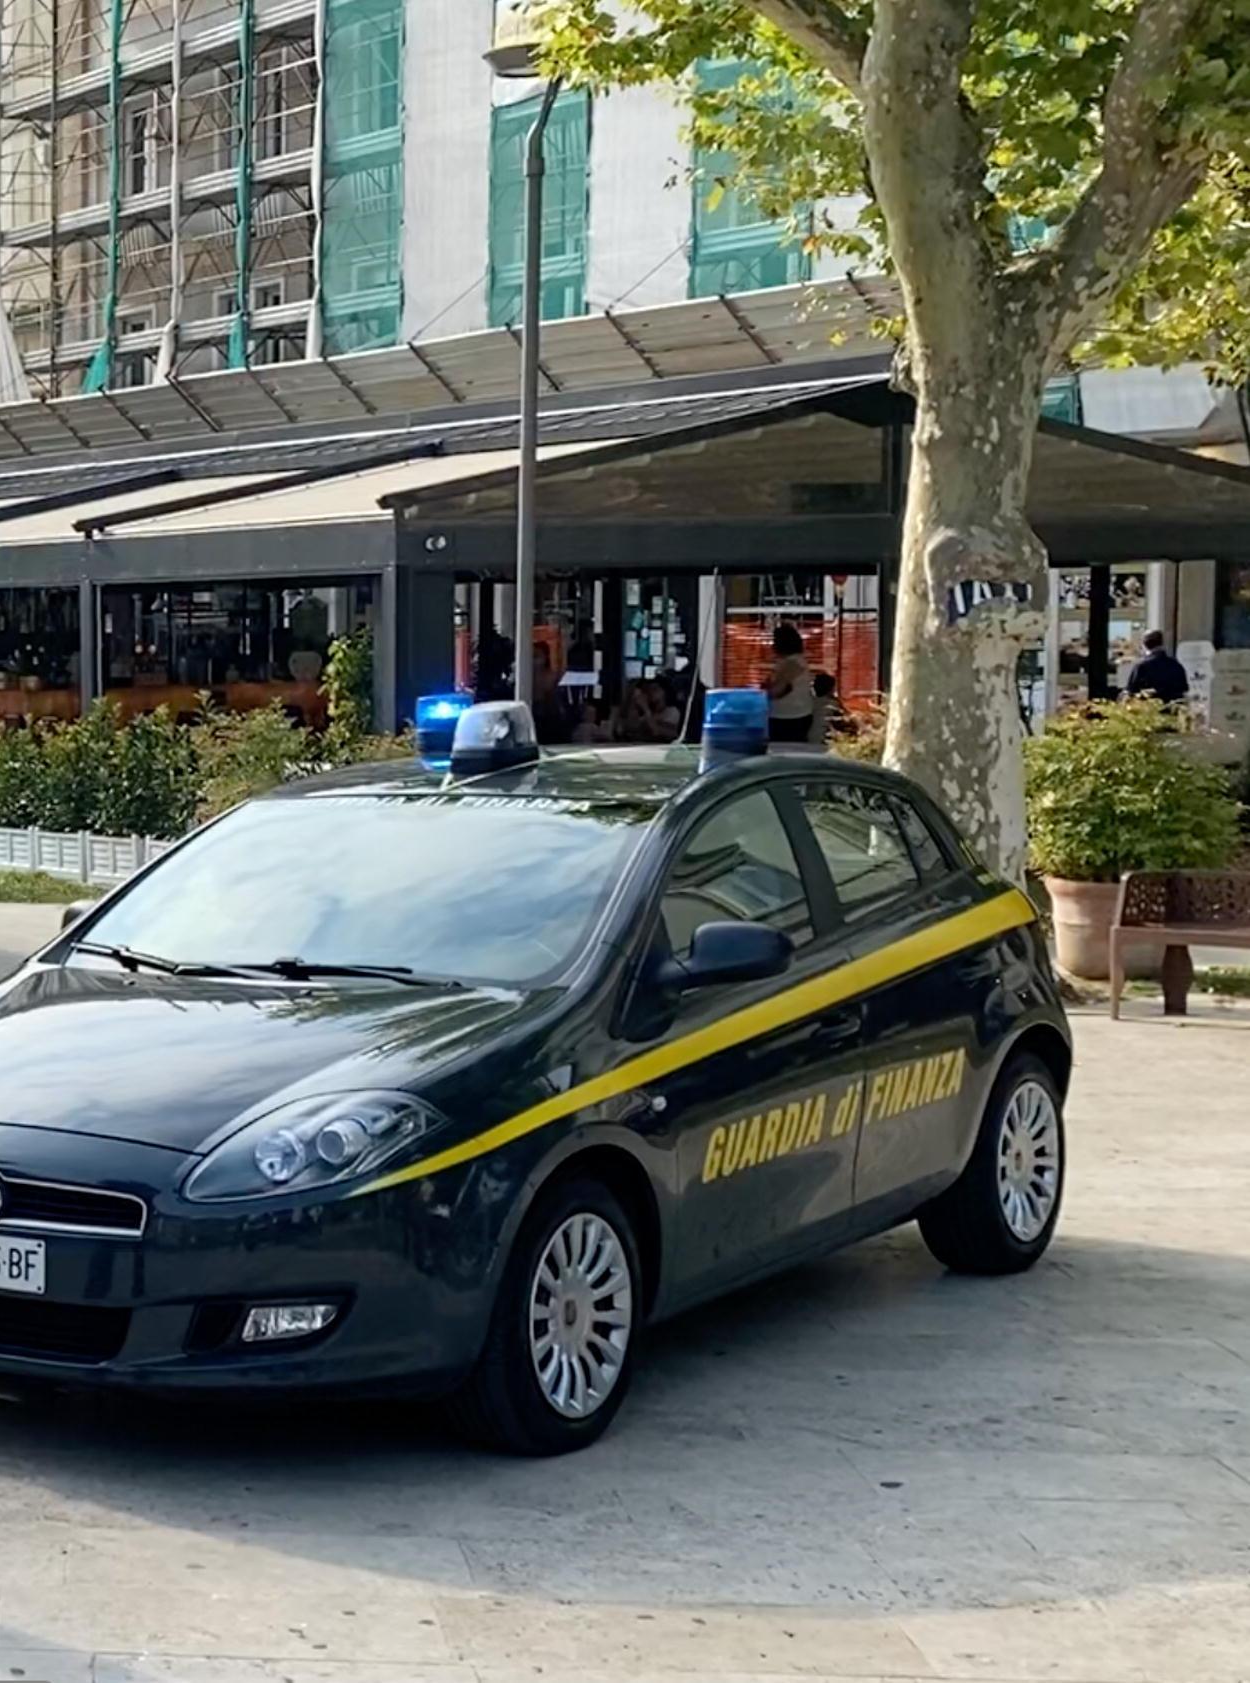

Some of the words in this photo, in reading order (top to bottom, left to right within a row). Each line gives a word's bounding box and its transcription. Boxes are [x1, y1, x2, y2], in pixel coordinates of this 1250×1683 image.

[703, 1093, 828, 1184] GUARDIA
[831, 1080, 863, 1137] di
[864, 1046, 966, 1125] FINANZA
